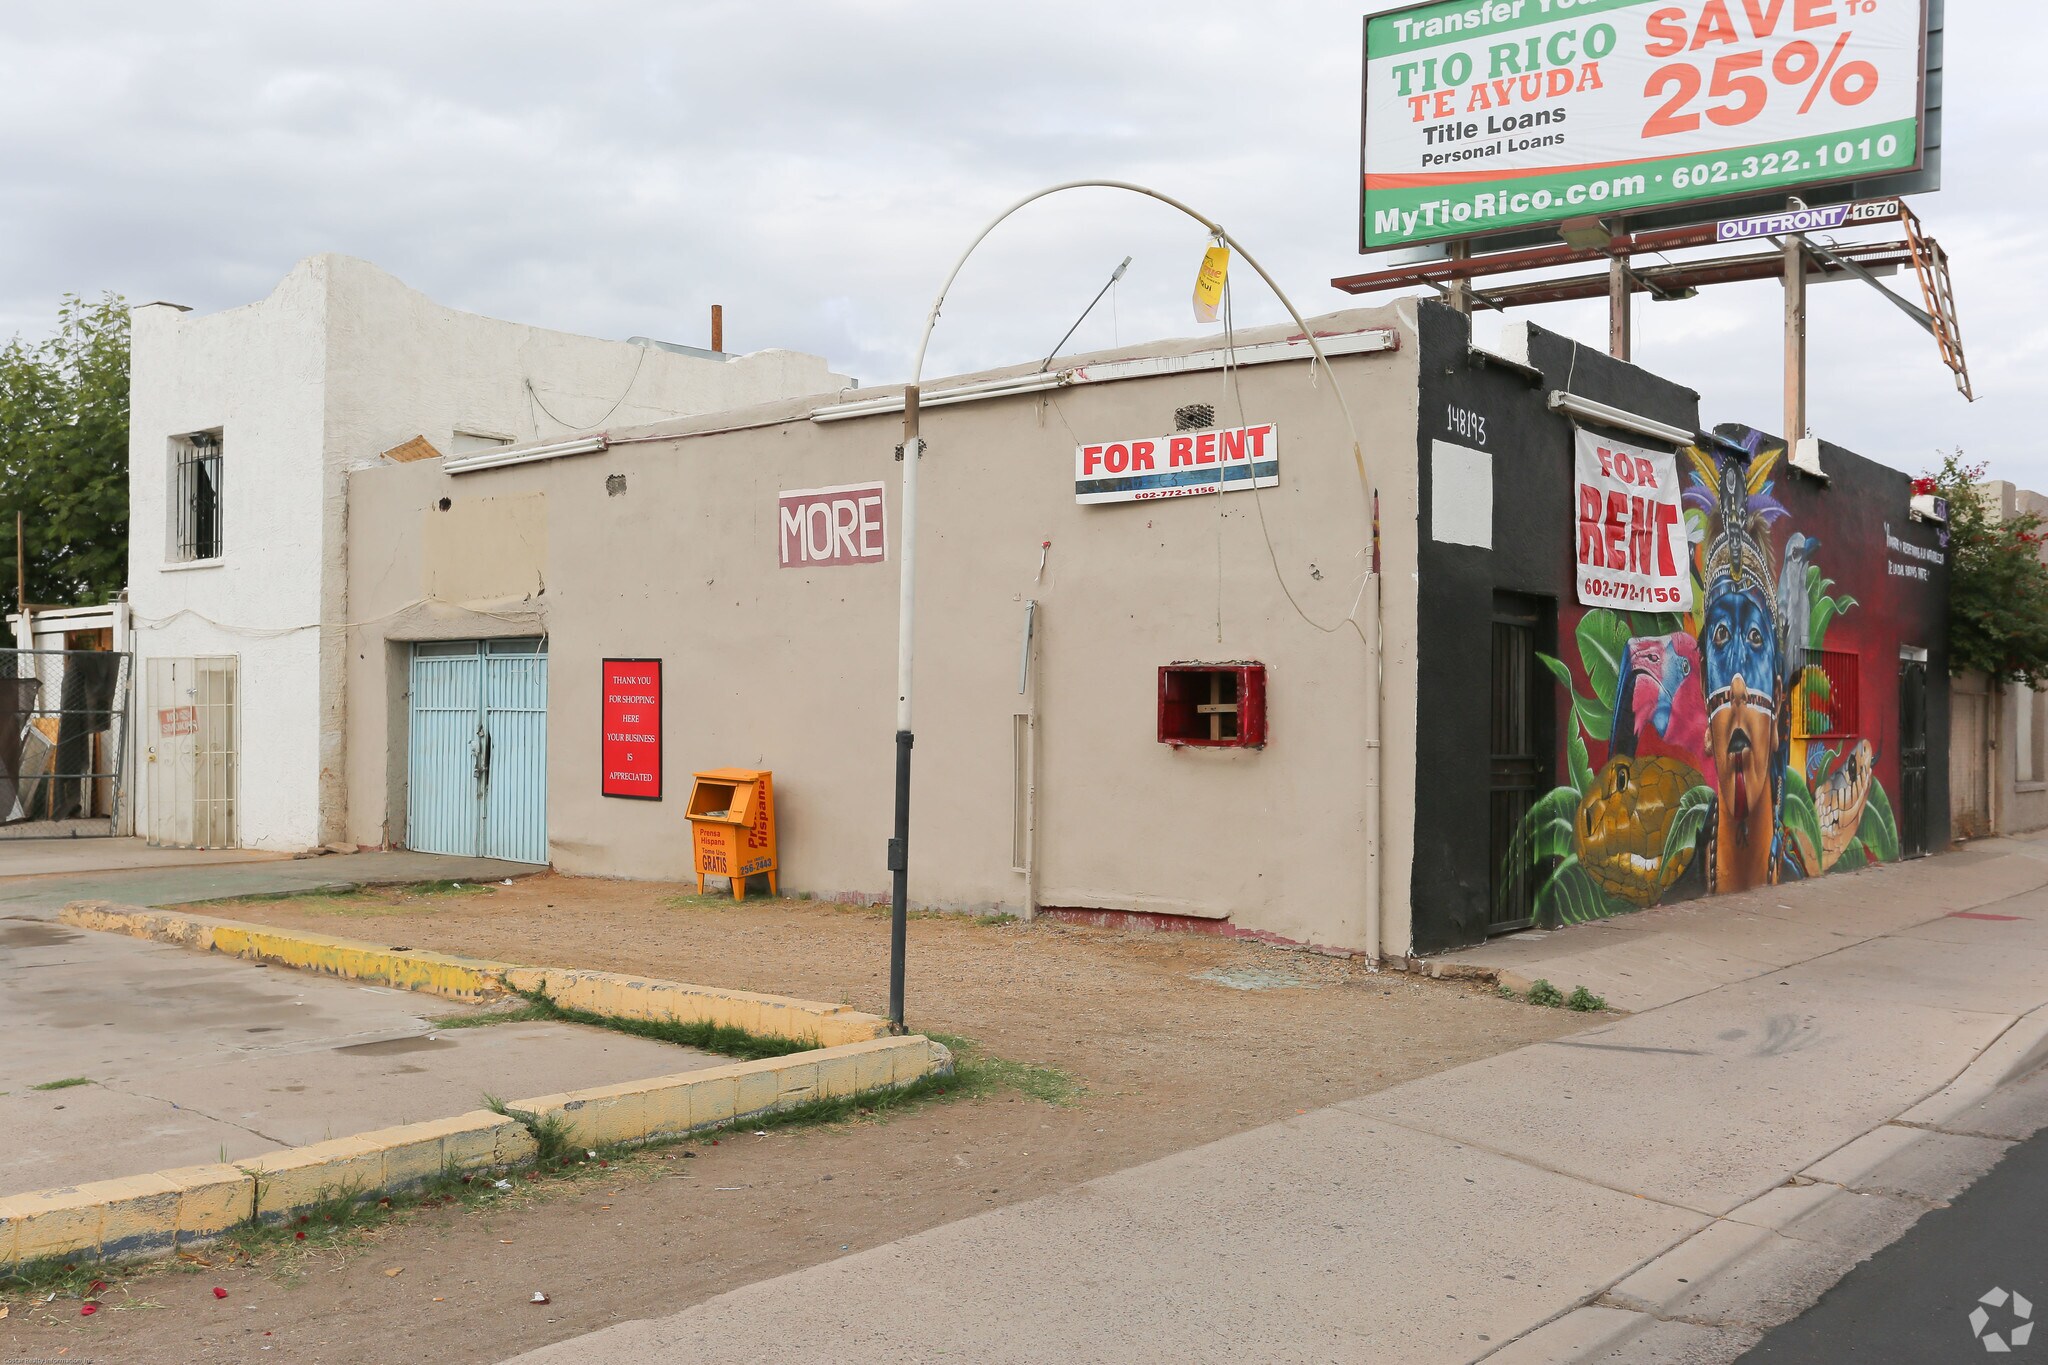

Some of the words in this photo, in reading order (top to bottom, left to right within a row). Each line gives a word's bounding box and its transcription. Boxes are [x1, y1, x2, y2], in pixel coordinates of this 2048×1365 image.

[1393, 0, 1526, 43] Transfer
[1645, 0, 1837, 58] SAVE
[1392, 52, 1473, 97] TIO
[1488, 23, 1617, 79] RICO
[1408, 89, 1455, 123] TE
[1467, 61, 1603, 113] AYUDA
[1641, 31, 1879, 139] 25%
[1423, 121, 1478, 145] Title
[1487, 107, 1566, 134] Loans
[1422, 141, 1501, 167] Personal
[1508, 133, 1565, 152] Loans
[1374, 174, 1645, 236] MyTioRico.com
[1672, 134, 1897, 188] 602.322.1010
[1721, 208, 1844, 238] OUTFRONT
[1855, 203, 1897, 218] 1670
[1447, 404, 1487, 445] 148193
[1083, 441, 1154, 475] FOR
[1169, 425, 1272, 467] RENT
[1597, 446, 1659, 489] FOR
[1134, 486, 1215, 500] 602-772-1156
[781, 496, 882, 563] MORE
[1579, 483, 1677, 577] RENT
[1585, 578, 1681, 603] 602-772-1156
[613, 676, 636, 685] THANK
[637, 676, 651, 685] YOU
[609, 694, 622, 703] FOR
[622, 695, 655, 704] SHOPPING
[166, 711, 179, 722] NO
[622, 714, 639, 723] HERE
[607, 733, 624, 742] YOUR
[625, 733, 655, 743] BUSINESS
[627, 753, 633, 761] IS
[609, 771, 652, 782] APPRECIATED
[758, 780, 768, 848] Hispana
[699, 828, 721, 838] Prensa
[700, 838, 725, 846] Hispana
[702, 855, 727, 874] GRATIS
